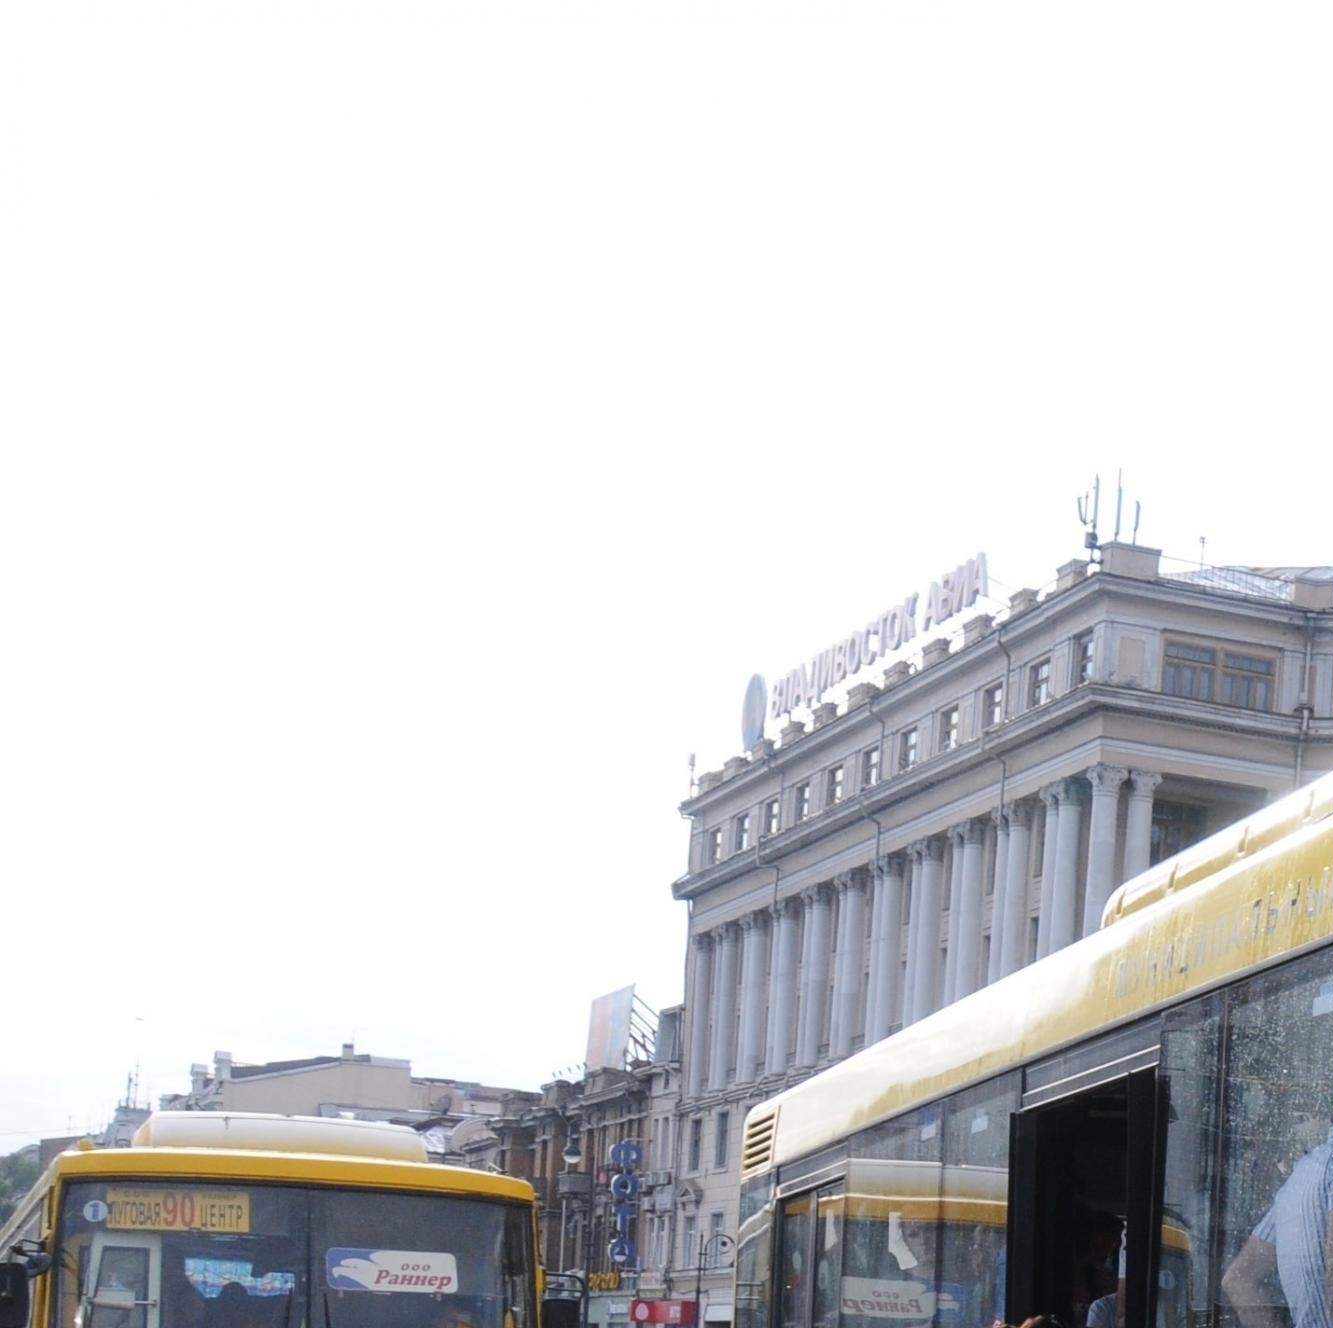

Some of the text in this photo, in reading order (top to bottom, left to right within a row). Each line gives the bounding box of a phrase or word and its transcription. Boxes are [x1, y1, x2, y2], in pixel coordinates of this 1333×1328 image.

[770, 551, 989, 718] ВЛАДИВОСТОК АВИА
[162, 1191, 195, 1228] 90
[200, 1204, 243, 1229] ЦЕНТР
[374, 1269, 452, 1290] Раннер
